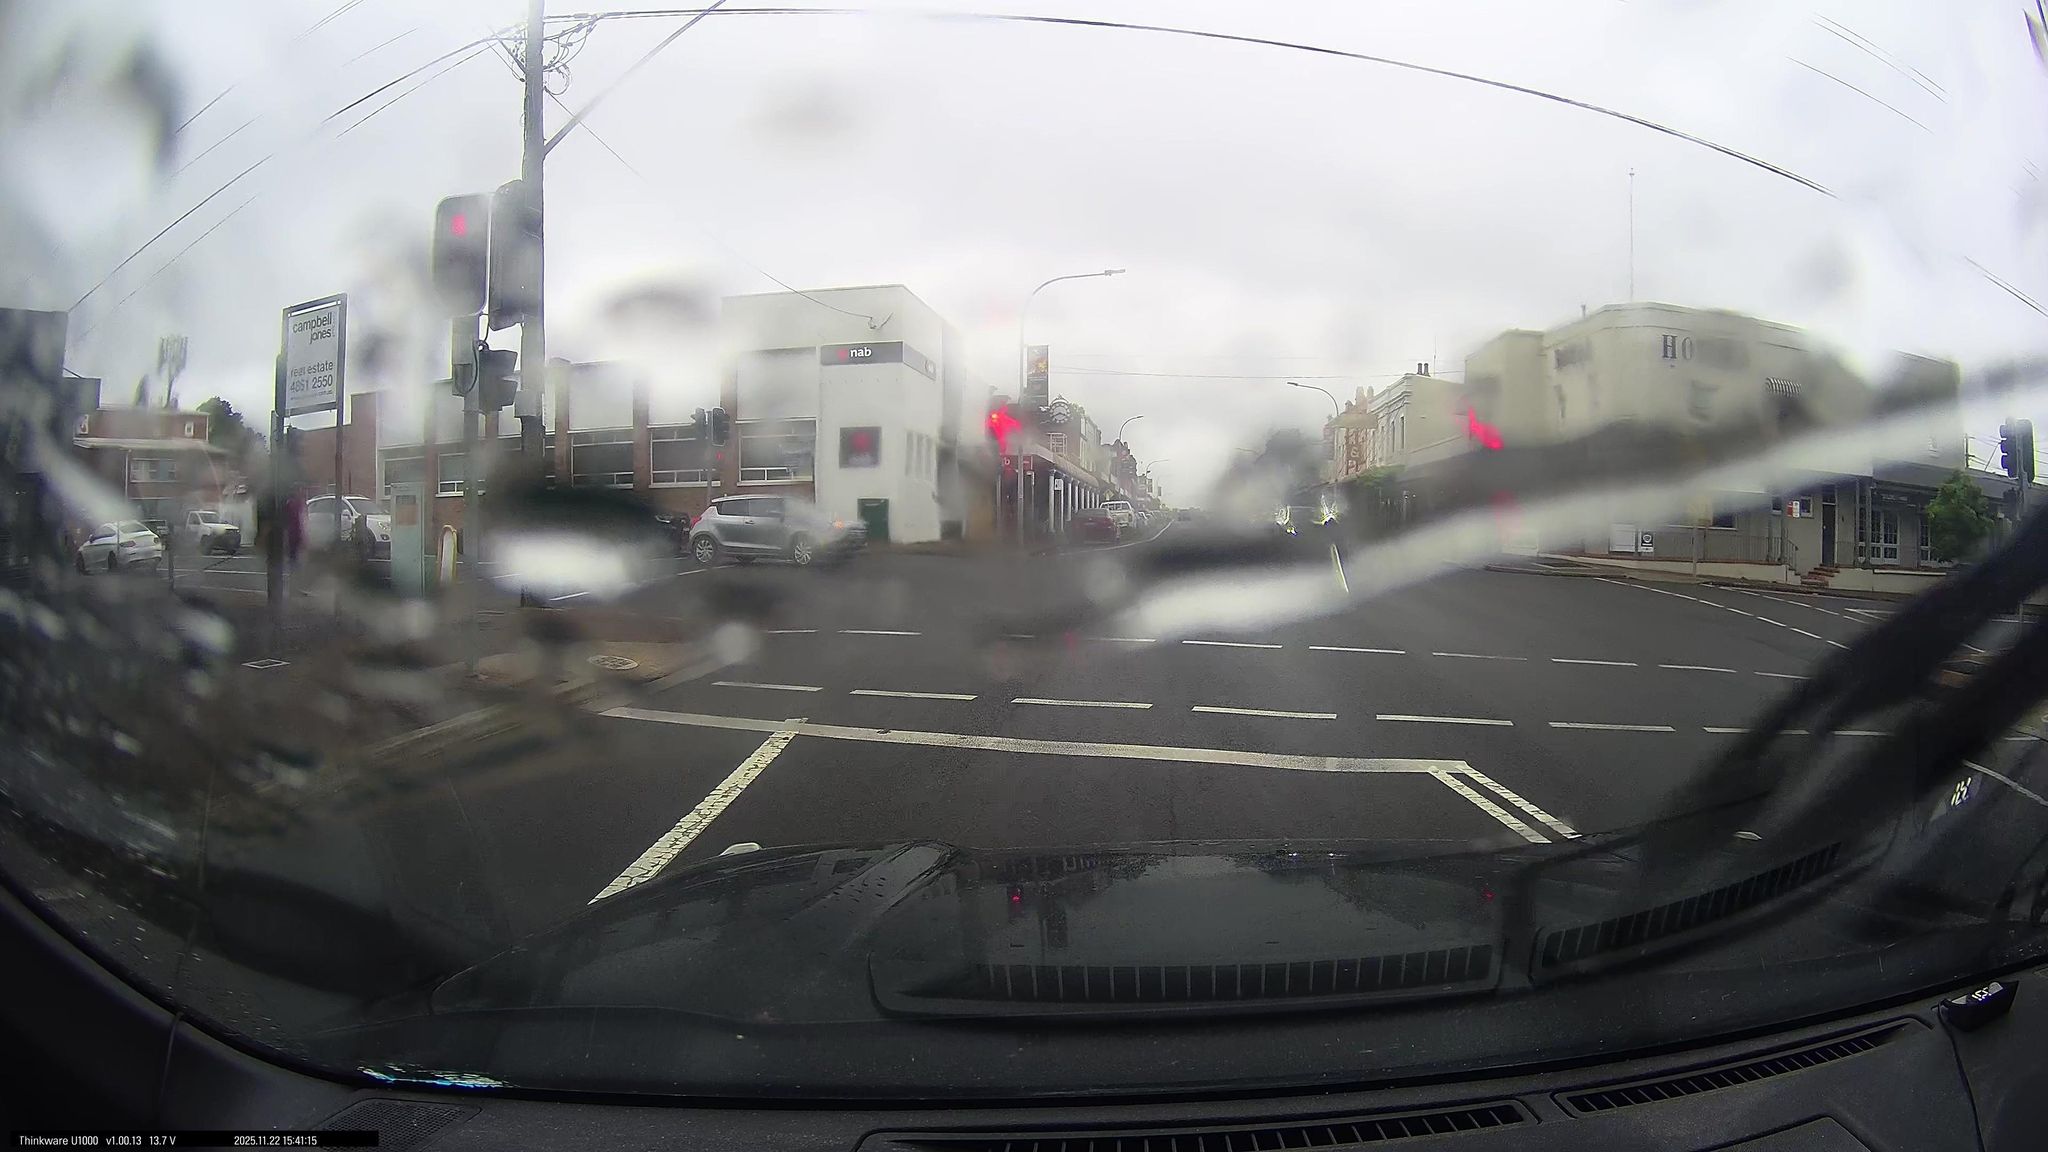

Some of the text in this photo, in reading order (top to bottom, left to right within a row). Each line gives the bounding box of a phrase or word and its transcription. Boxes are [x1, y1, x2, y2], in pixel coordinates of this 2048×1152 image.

[293, 312, 332, 333] campbell
[310, 328, 332, 344] jones
[850, 347, 872, 357] nab
[307, 361, 334, 375] estate
[312, 374, 333, 389] 2550
